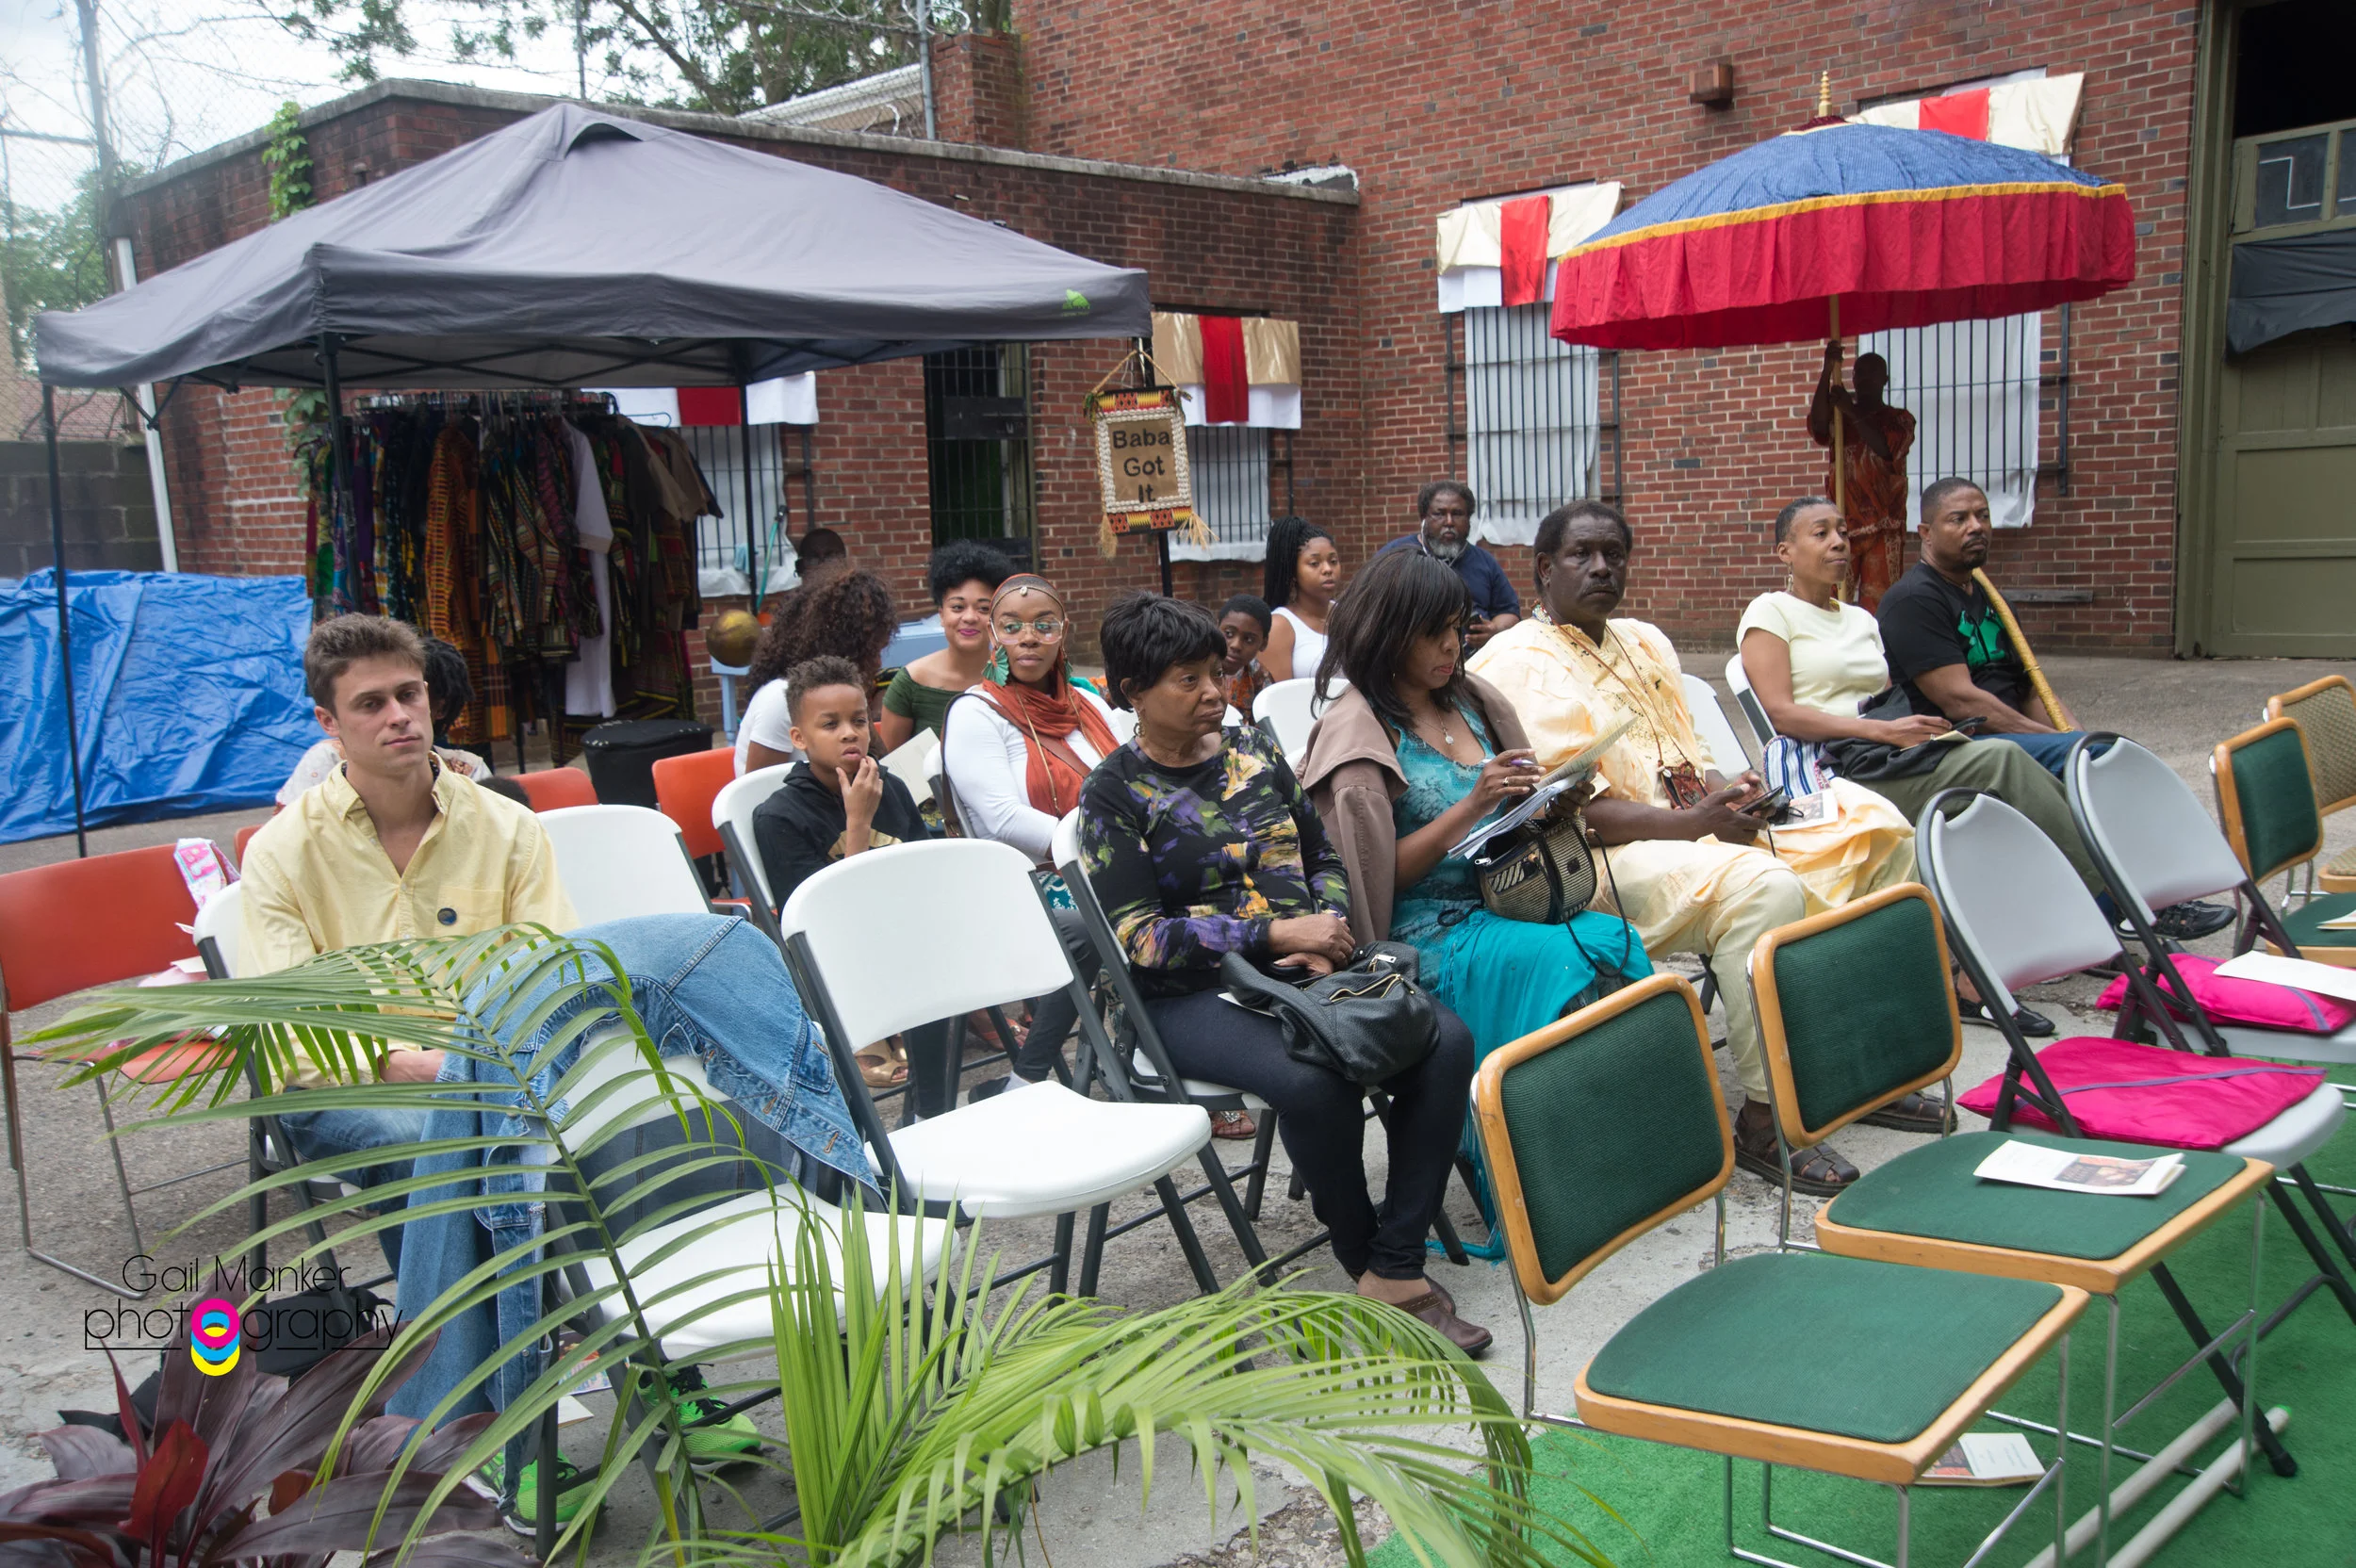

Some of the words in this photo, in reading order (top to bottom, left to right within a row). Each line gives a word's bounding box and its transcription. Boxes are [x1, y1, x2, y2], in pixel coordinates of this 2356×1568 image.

[1112, 428, 1171, 449] Baba
[1123, 455, 1166, 478] Got
[1137, 483, 1156, 504] It
